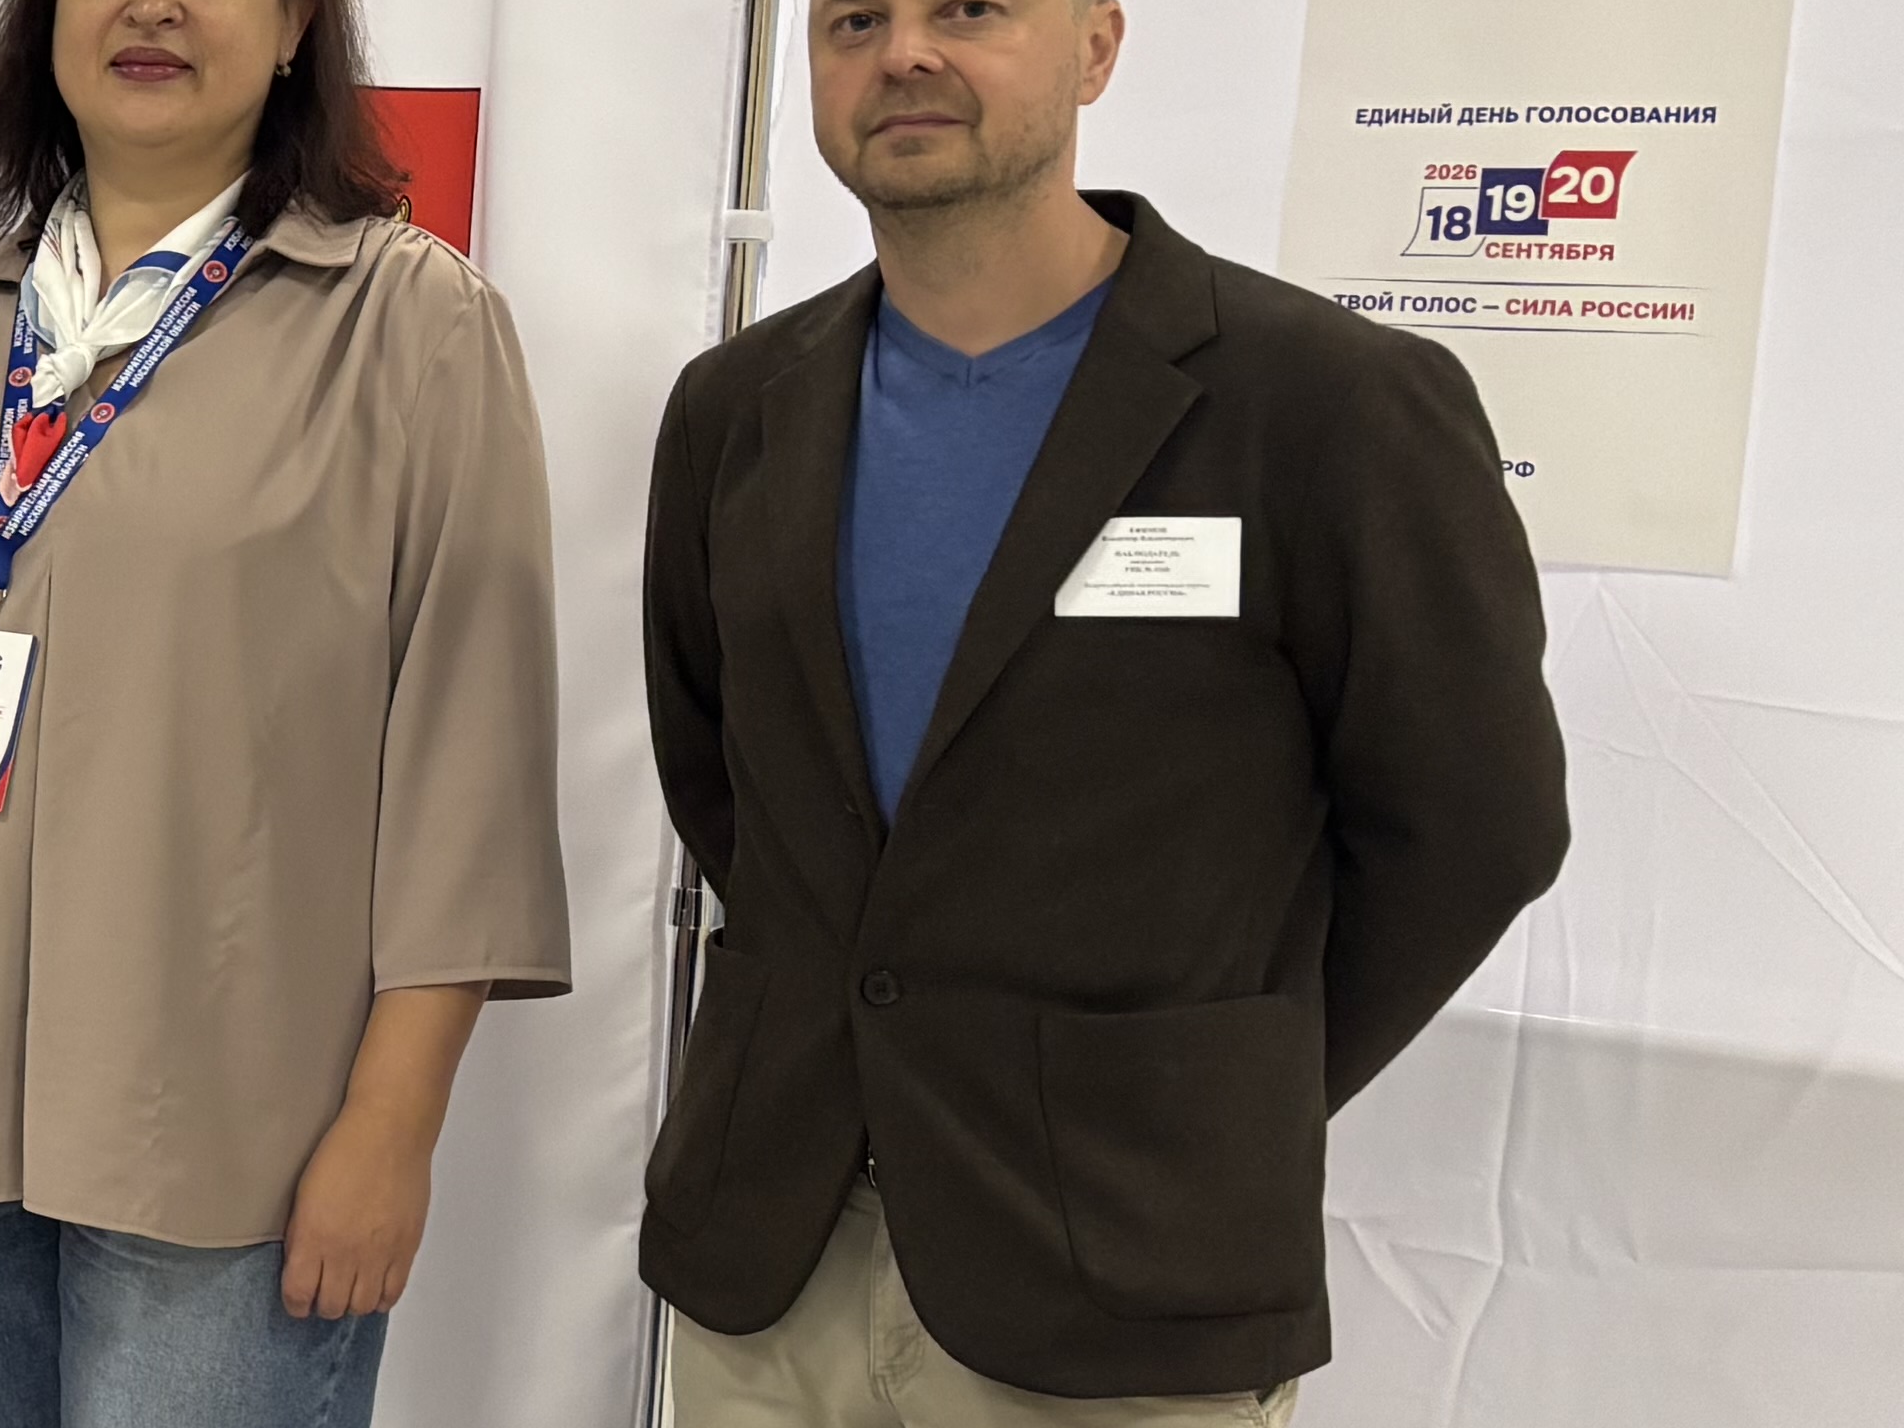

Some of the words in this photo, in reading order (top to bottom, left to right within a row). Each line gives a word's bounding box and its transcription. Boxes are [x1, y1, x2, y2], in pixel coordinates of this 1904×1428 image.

[1355, 103, 1452, 127] ЕДИНЫЙ
[1456, 105, 1519, 127] ДЕНЬ
[1525, 105, 1717, 125] ГОЛОСОВАНИЯ
[1424, 164, 1478, 181] 2026
[1425, 205, 1472, 241] 18
[1485, 184, 1536, 222] 19
[1548, 166, 1616, 204] 20
[1484, 240, 1616, 262] СЕНТЯБРЯ
[111, 328, 165, 392] ИЗБИРАТЕЛЬНАЯ
[159, 285, 198, 330] КОМИССИЯ
[1333, 291, 1394, 312] ТВОЙ
[1399, 296, 1478, 314] ГОЛОС
[1504, 298, 1574, 319] СИЛА
[1580, 301, 1695, 322] РОССИИ!
[128, 335, 174, 388] МОСКОВСКОЙ
[169, 301, 202, 338] ОБЛАСТИ
[0, 472, 53, 540] ИЗБИРАТЕЛЬНАЯ
[47, 430, 86, 475] КОМИССИЯ
[18, 479, 63, 537] МОСКОВСКОЙ
[56, 444, 89, 480] ОБЛАСТИ
